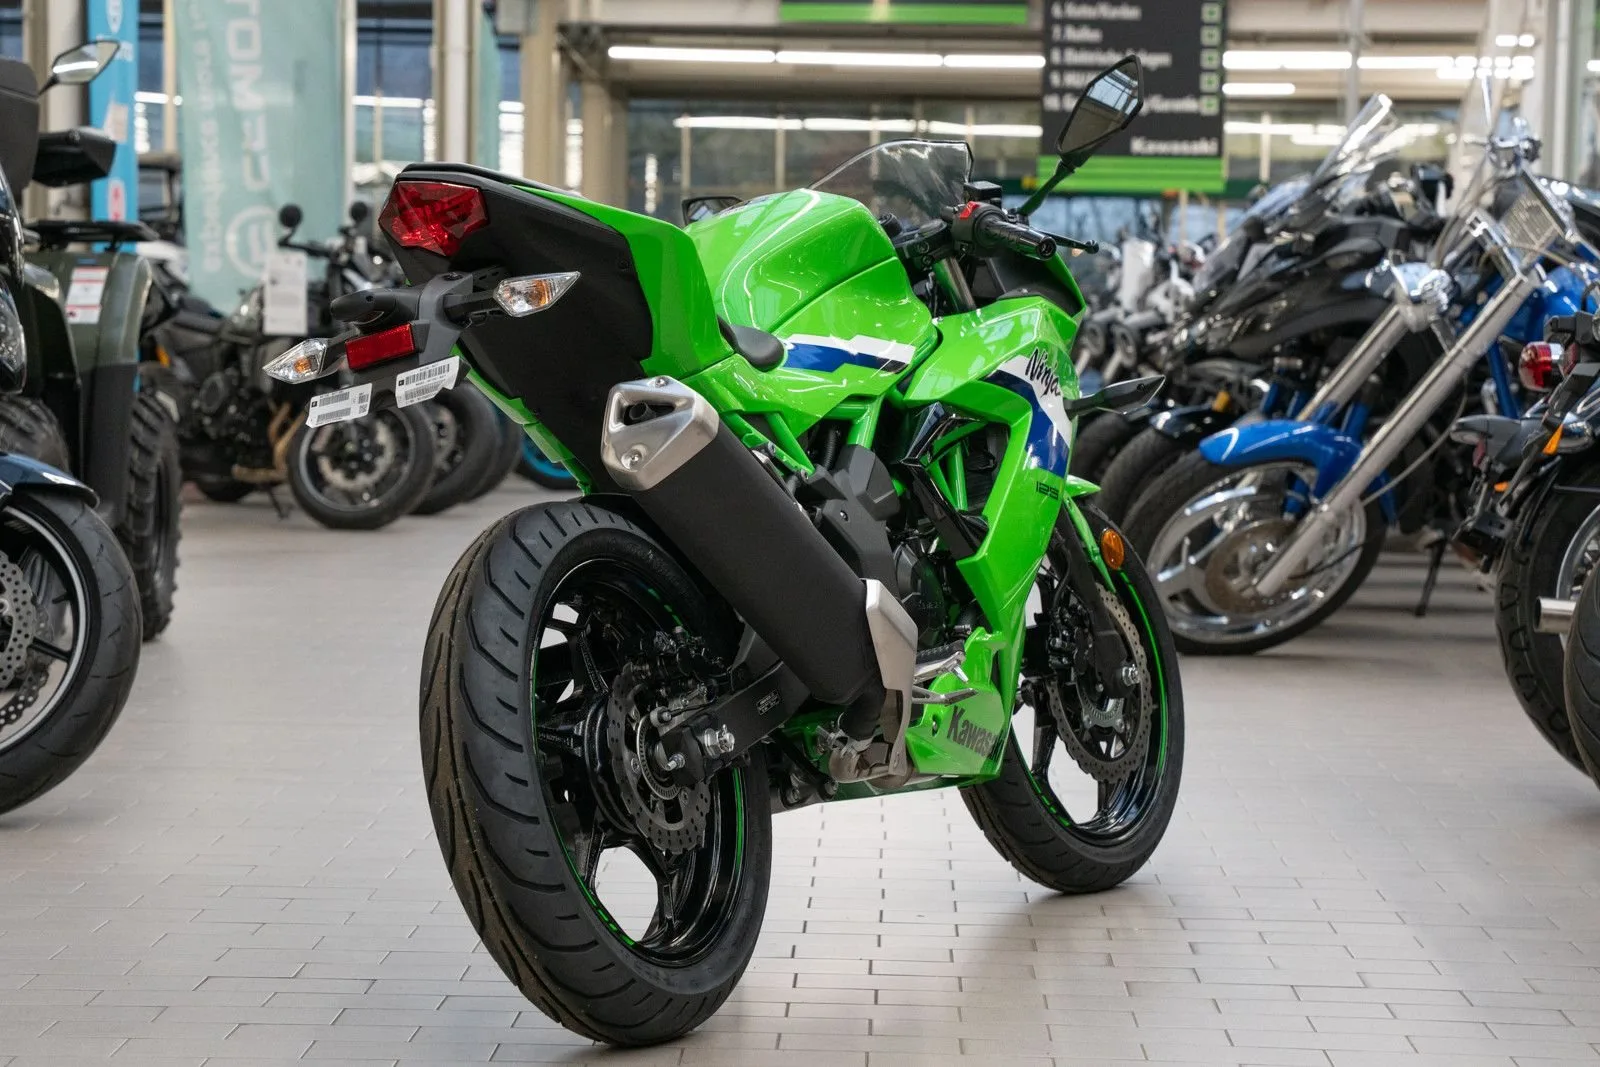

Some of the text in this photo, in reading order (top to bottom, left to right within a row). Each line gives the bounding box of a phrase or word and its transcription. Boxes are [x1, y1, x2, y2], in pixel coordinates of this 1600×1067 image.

[1130, 136, 1218, 155] Kawasaki
[1025, 348, 1061, 398] Ninja
[1036, 481, 1059, 500] 125
